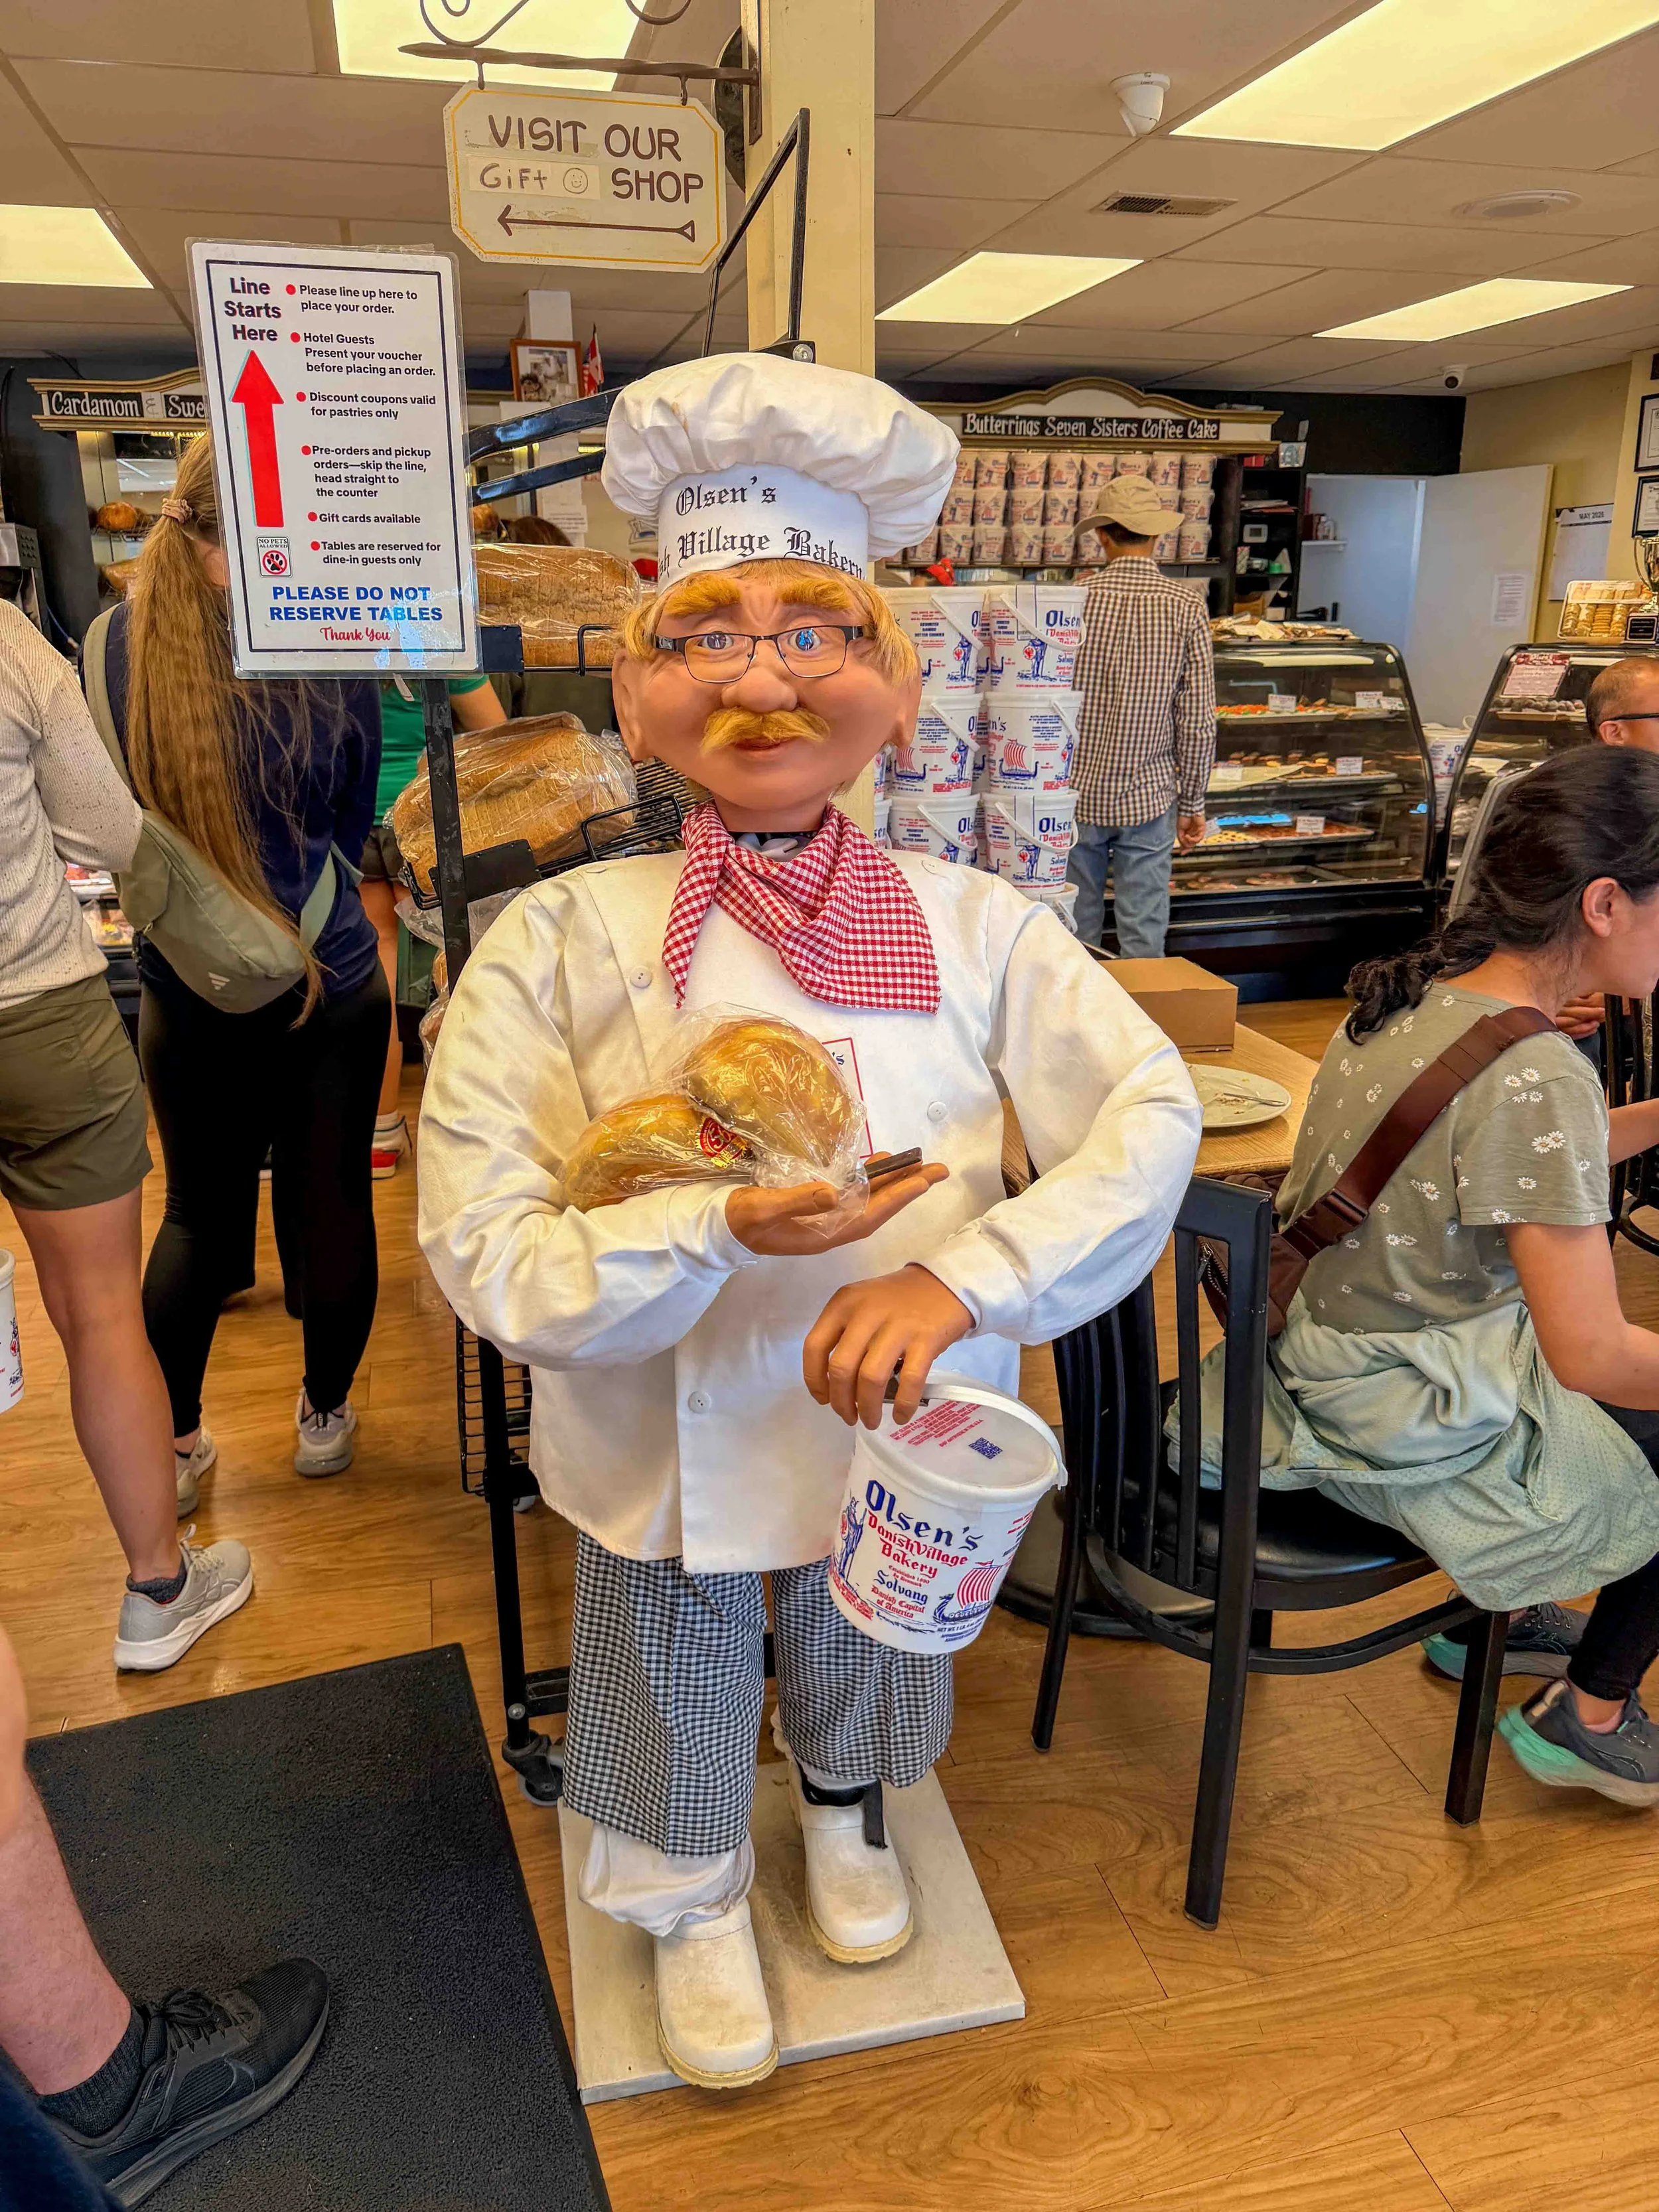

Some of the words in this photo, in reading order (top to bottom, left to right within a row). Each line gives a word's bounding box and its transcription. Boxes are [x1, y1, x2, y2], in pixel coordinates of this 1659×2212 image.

[488, 115, 587, 153] VISIT
[605, 124, 681, 161] OUR
[611, 168, 703, 204] SHOP
[230, 277, 270, 295] Line
[299, 285, 336, 297] Please
[340, 287, 359, 297] line
[362, 291, 376, 300] up
[378, 289, 403, 299] here
[405, 290, 417, 300] to
[224, 301, 281, 319] Starts
[301, 301, 332, 313] place
[334, 304, 359, 313] your
[362, 303, 395, 314] order.
[232, 325, 277, 341] Here
[304, 333, 333, 343] Hotel
[336, 334, 374, 344] Guests
[305, 348, 348, 358] Present
[351, 350, 375, 360] your
[378, 351, 422, 361] voucher
[307, 362, 343, 373] before
[346, 364, 386, 376] placing
[404, 366, 435, 376] order.
[52, 392, 140, 417] Cardamom
[309, 392, 358, 403] Discount
[361, 394, 407, 406] coupons
[410, 395, 435, 405] valid
[311, 407, 327, 416] for
[330, 407, 372, 418] pastries
[376, 409, 398, 419] only
[964, 413, 1040, 436] Butterrings
[1045, 417, 1086, 437] Seven
[1090, 418, 1138, 437] Sisters
[1142, 419, 1183, 439] Coffee
[1187, 420, 1217, 439] Cake
[312, 445, 369, 457] Pre-orders
[372, 447, 392, 457] and
[394, 448, 431, 458] pickup
[386, 461, 402, 471] the
[405, 462, 427, 473] line,
[315, 475, 342, 484] head
[344, 475, 386, 485] straight
[388, 476, 399, 484] to
[316, 488, 333, 497] the
[336, 488, 378, 498] counter
[676, 476, 776, 516] Olsen's
[319, 513, 339, 523] Gift
[342, 514, 372, 523] cards
[374, 514, 421, 524] available
[321, 542, 356, 551] Tables
[378, 542, 423, 552] reserved
[425, 542, 441, 551] for
[678, 526, 770, 567] Village
[323, 555, 359, 565] dine-in
[362, 556, 396, 565] guests
[399, 556, 421, 566] only
[273, 587, 349, 600] PLEASE
[356, 587, 383, 600] DO
[390, 587, 430, 600] NOT
[269, 607, 362, 621] RESERVE
[368, 607, 443, 621] TABLES
[320, 627, 363, 641] Thank
[364, 627, 391, 642] You
[866, 1480, 983, 1551] Olsen's
[880, 1537, 938, 1579] Bakery
[873, 1570, 928, 1605] Solvang
[871, 1585, 897, 1604] Danish
[899, 1601, 925, 1613] Capital
[885, 1603, 914, 1619] America
